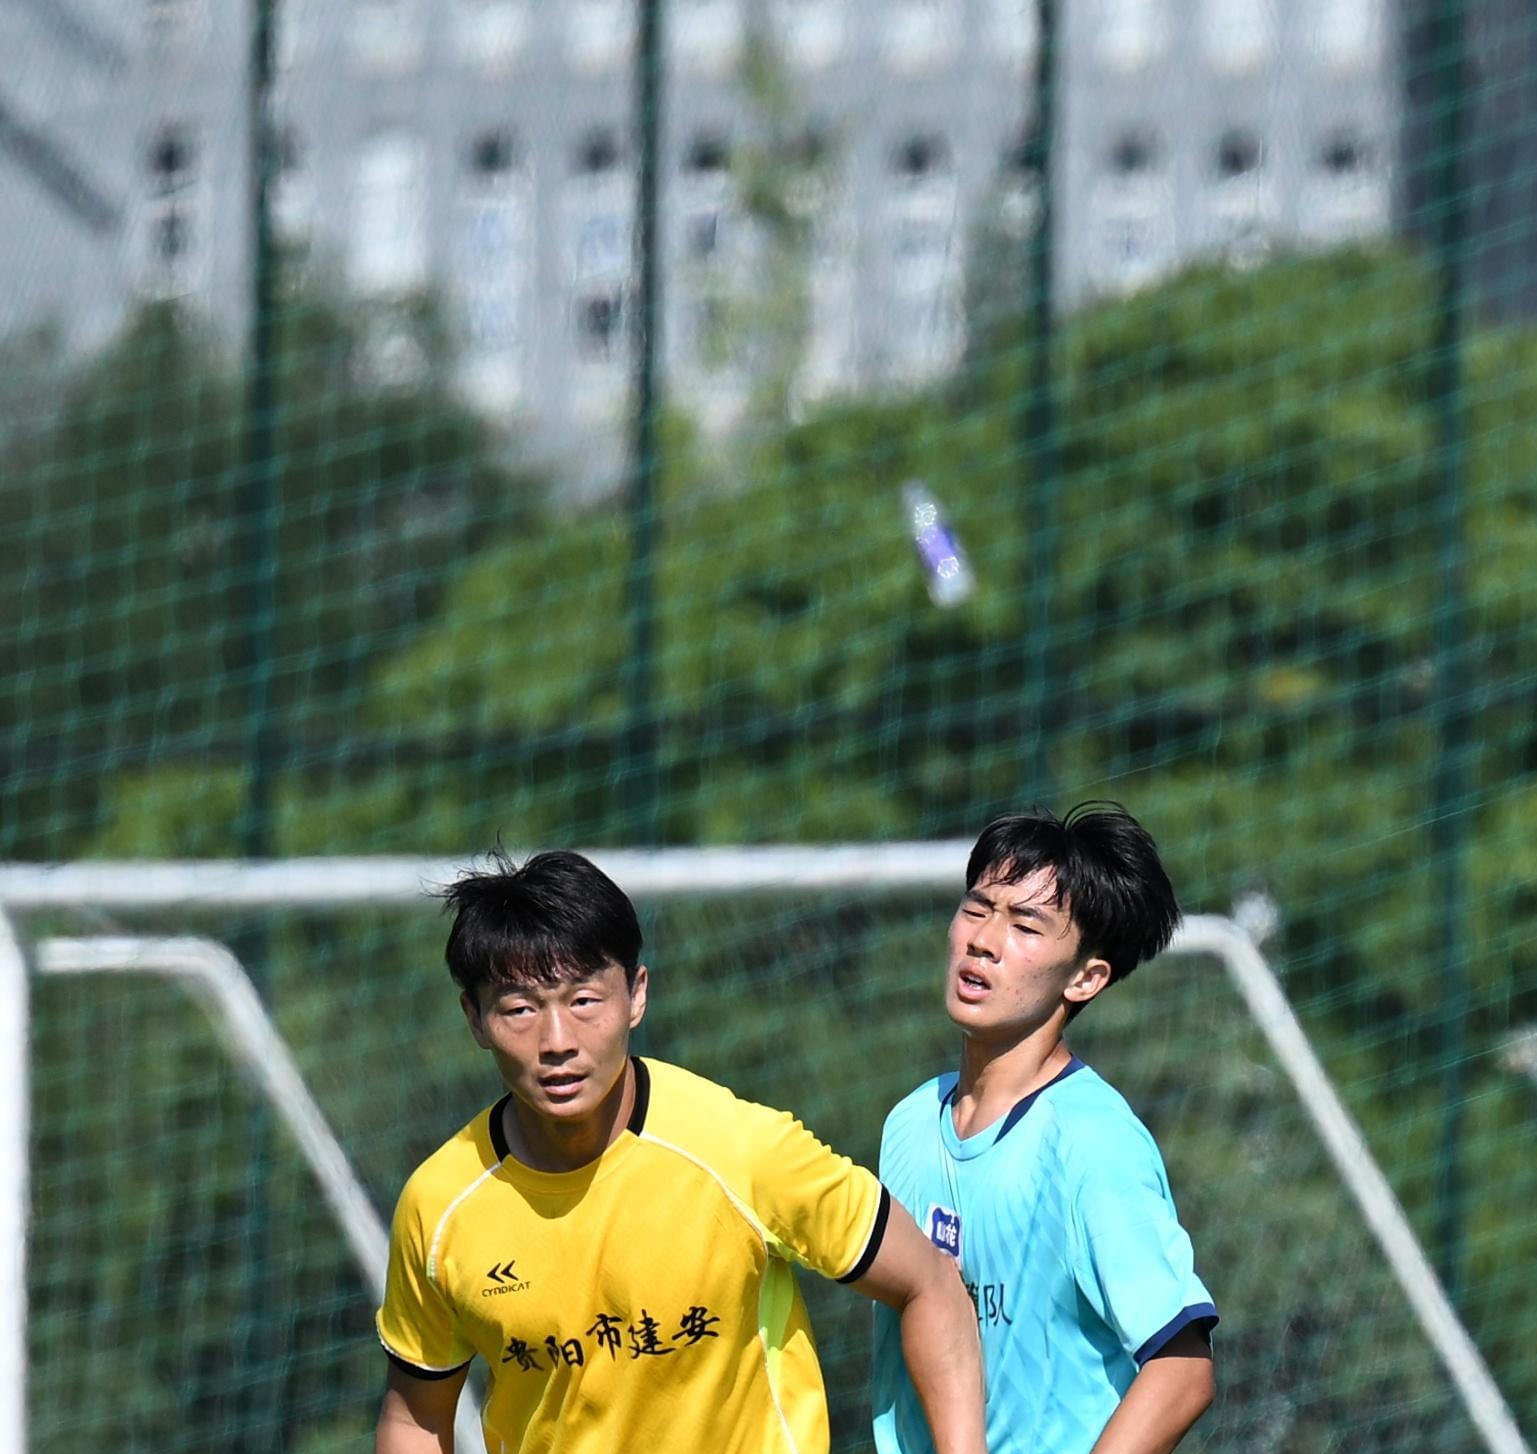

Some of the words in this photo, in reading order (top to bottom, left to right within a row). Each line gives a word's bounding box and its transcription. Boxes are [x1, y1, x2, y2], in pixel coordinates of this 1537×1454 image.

[502, 1306, 720, 1373] 贵阳市建安
